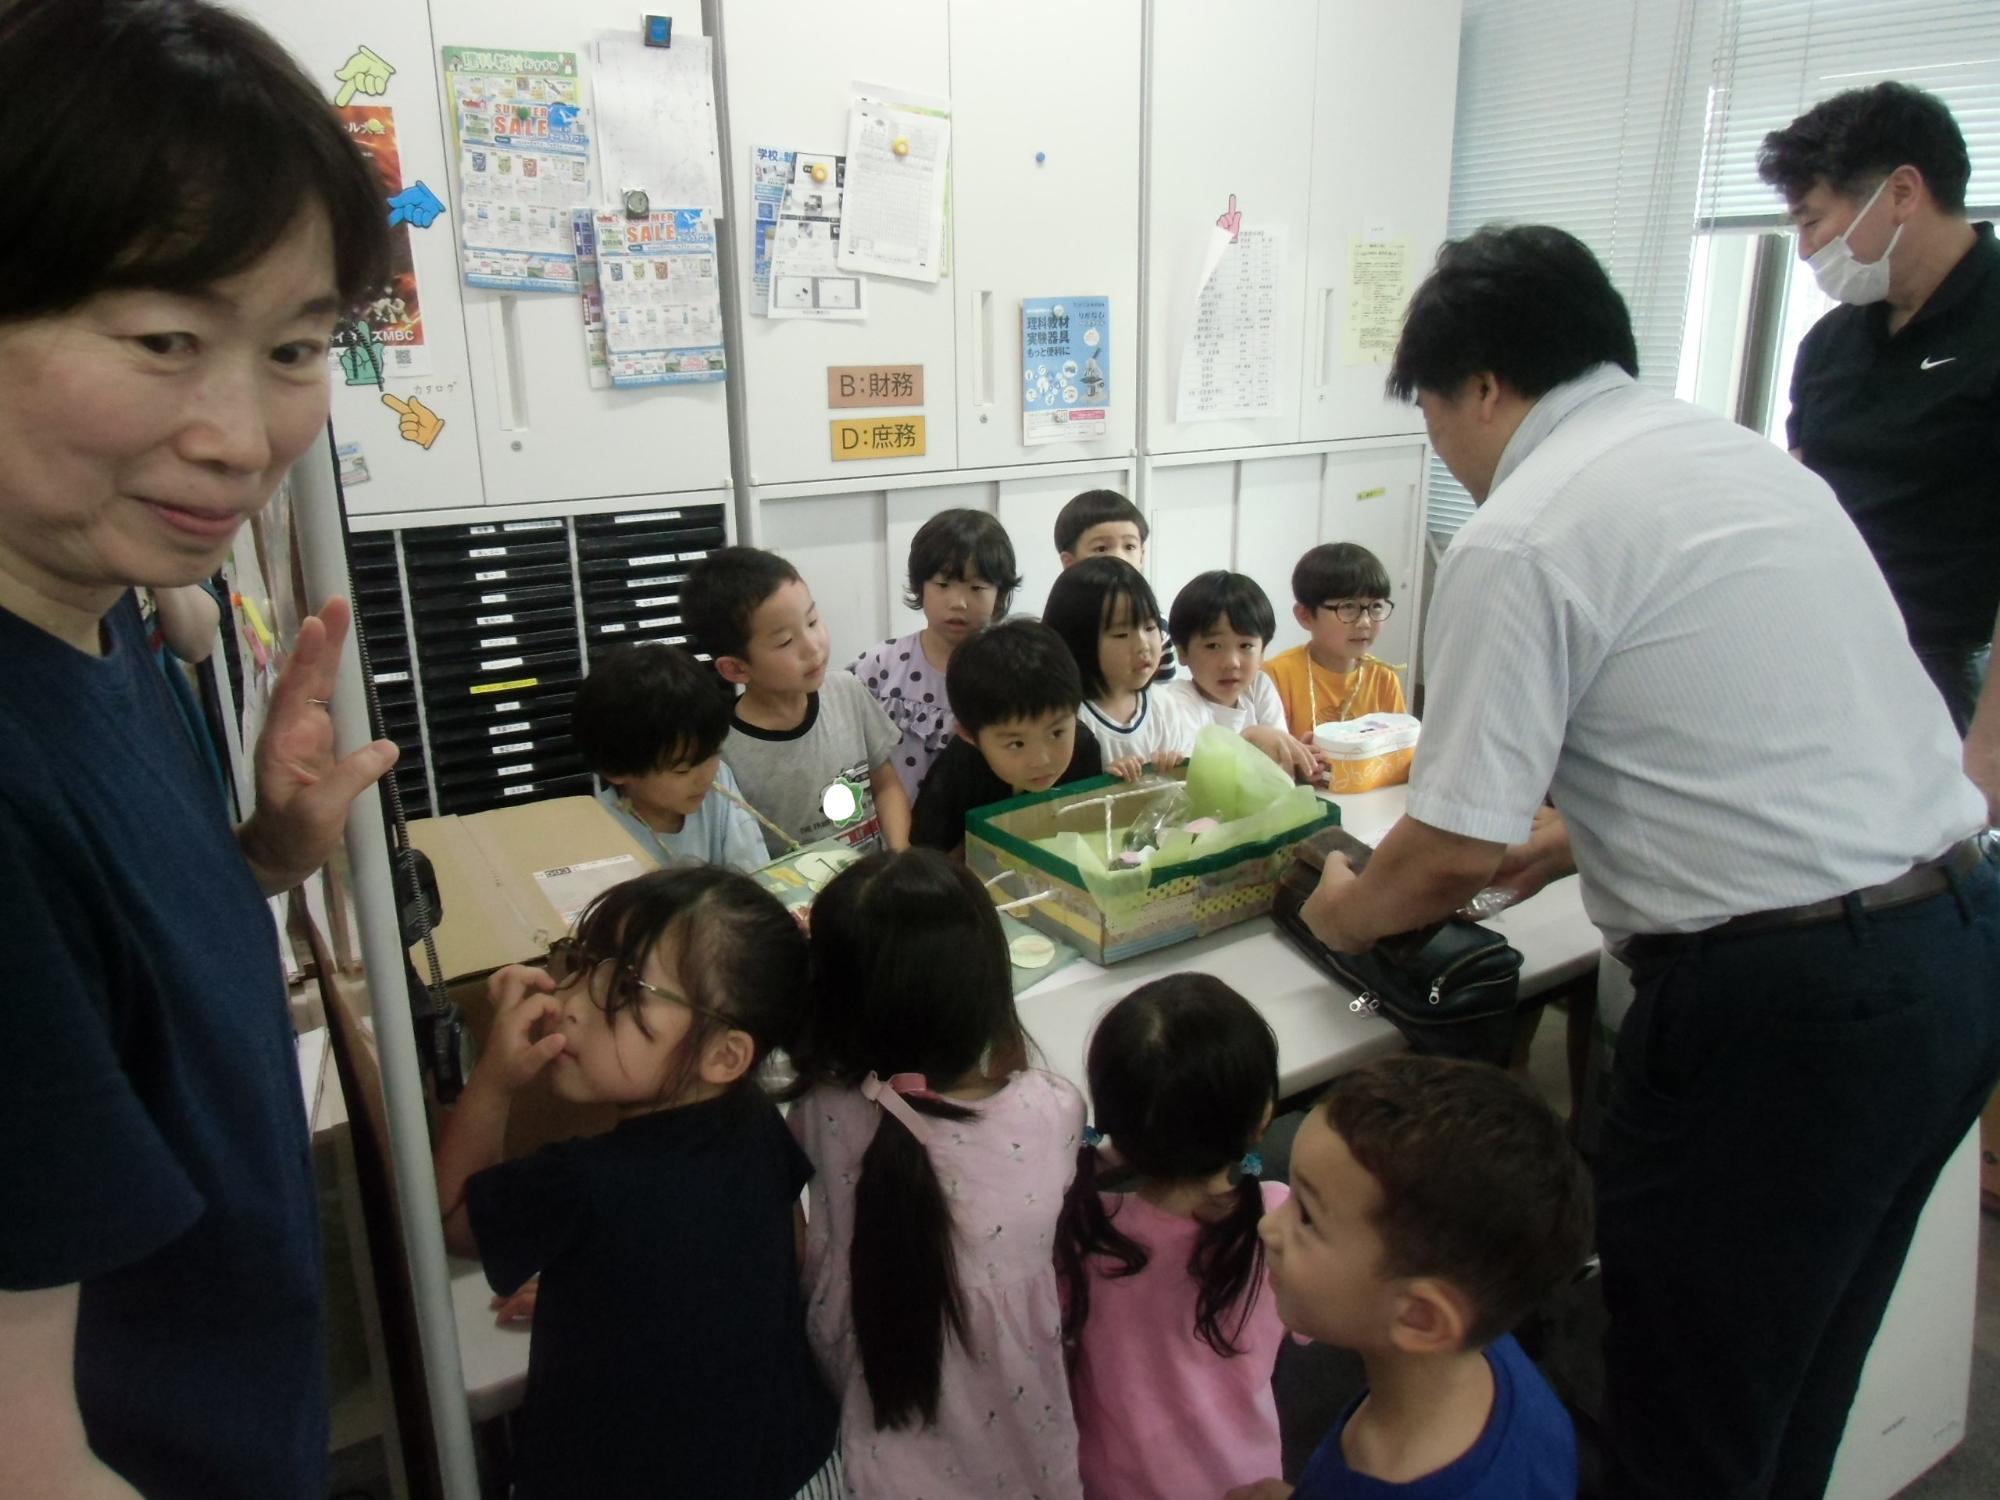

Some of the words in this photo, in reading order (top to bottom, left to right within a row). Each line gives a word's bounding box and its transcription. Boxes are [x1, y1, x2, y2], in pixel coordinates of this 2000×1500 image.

[494, 103, 548, 117] SUER
[494, 116, 548, 137] SALE
[626, 223, 675, 243] SALE
[1026, 330, 1070, 346] 実験器具
[840, 372, 913, 397] B:財務
[841, 423, 916, 449] D:庶務
